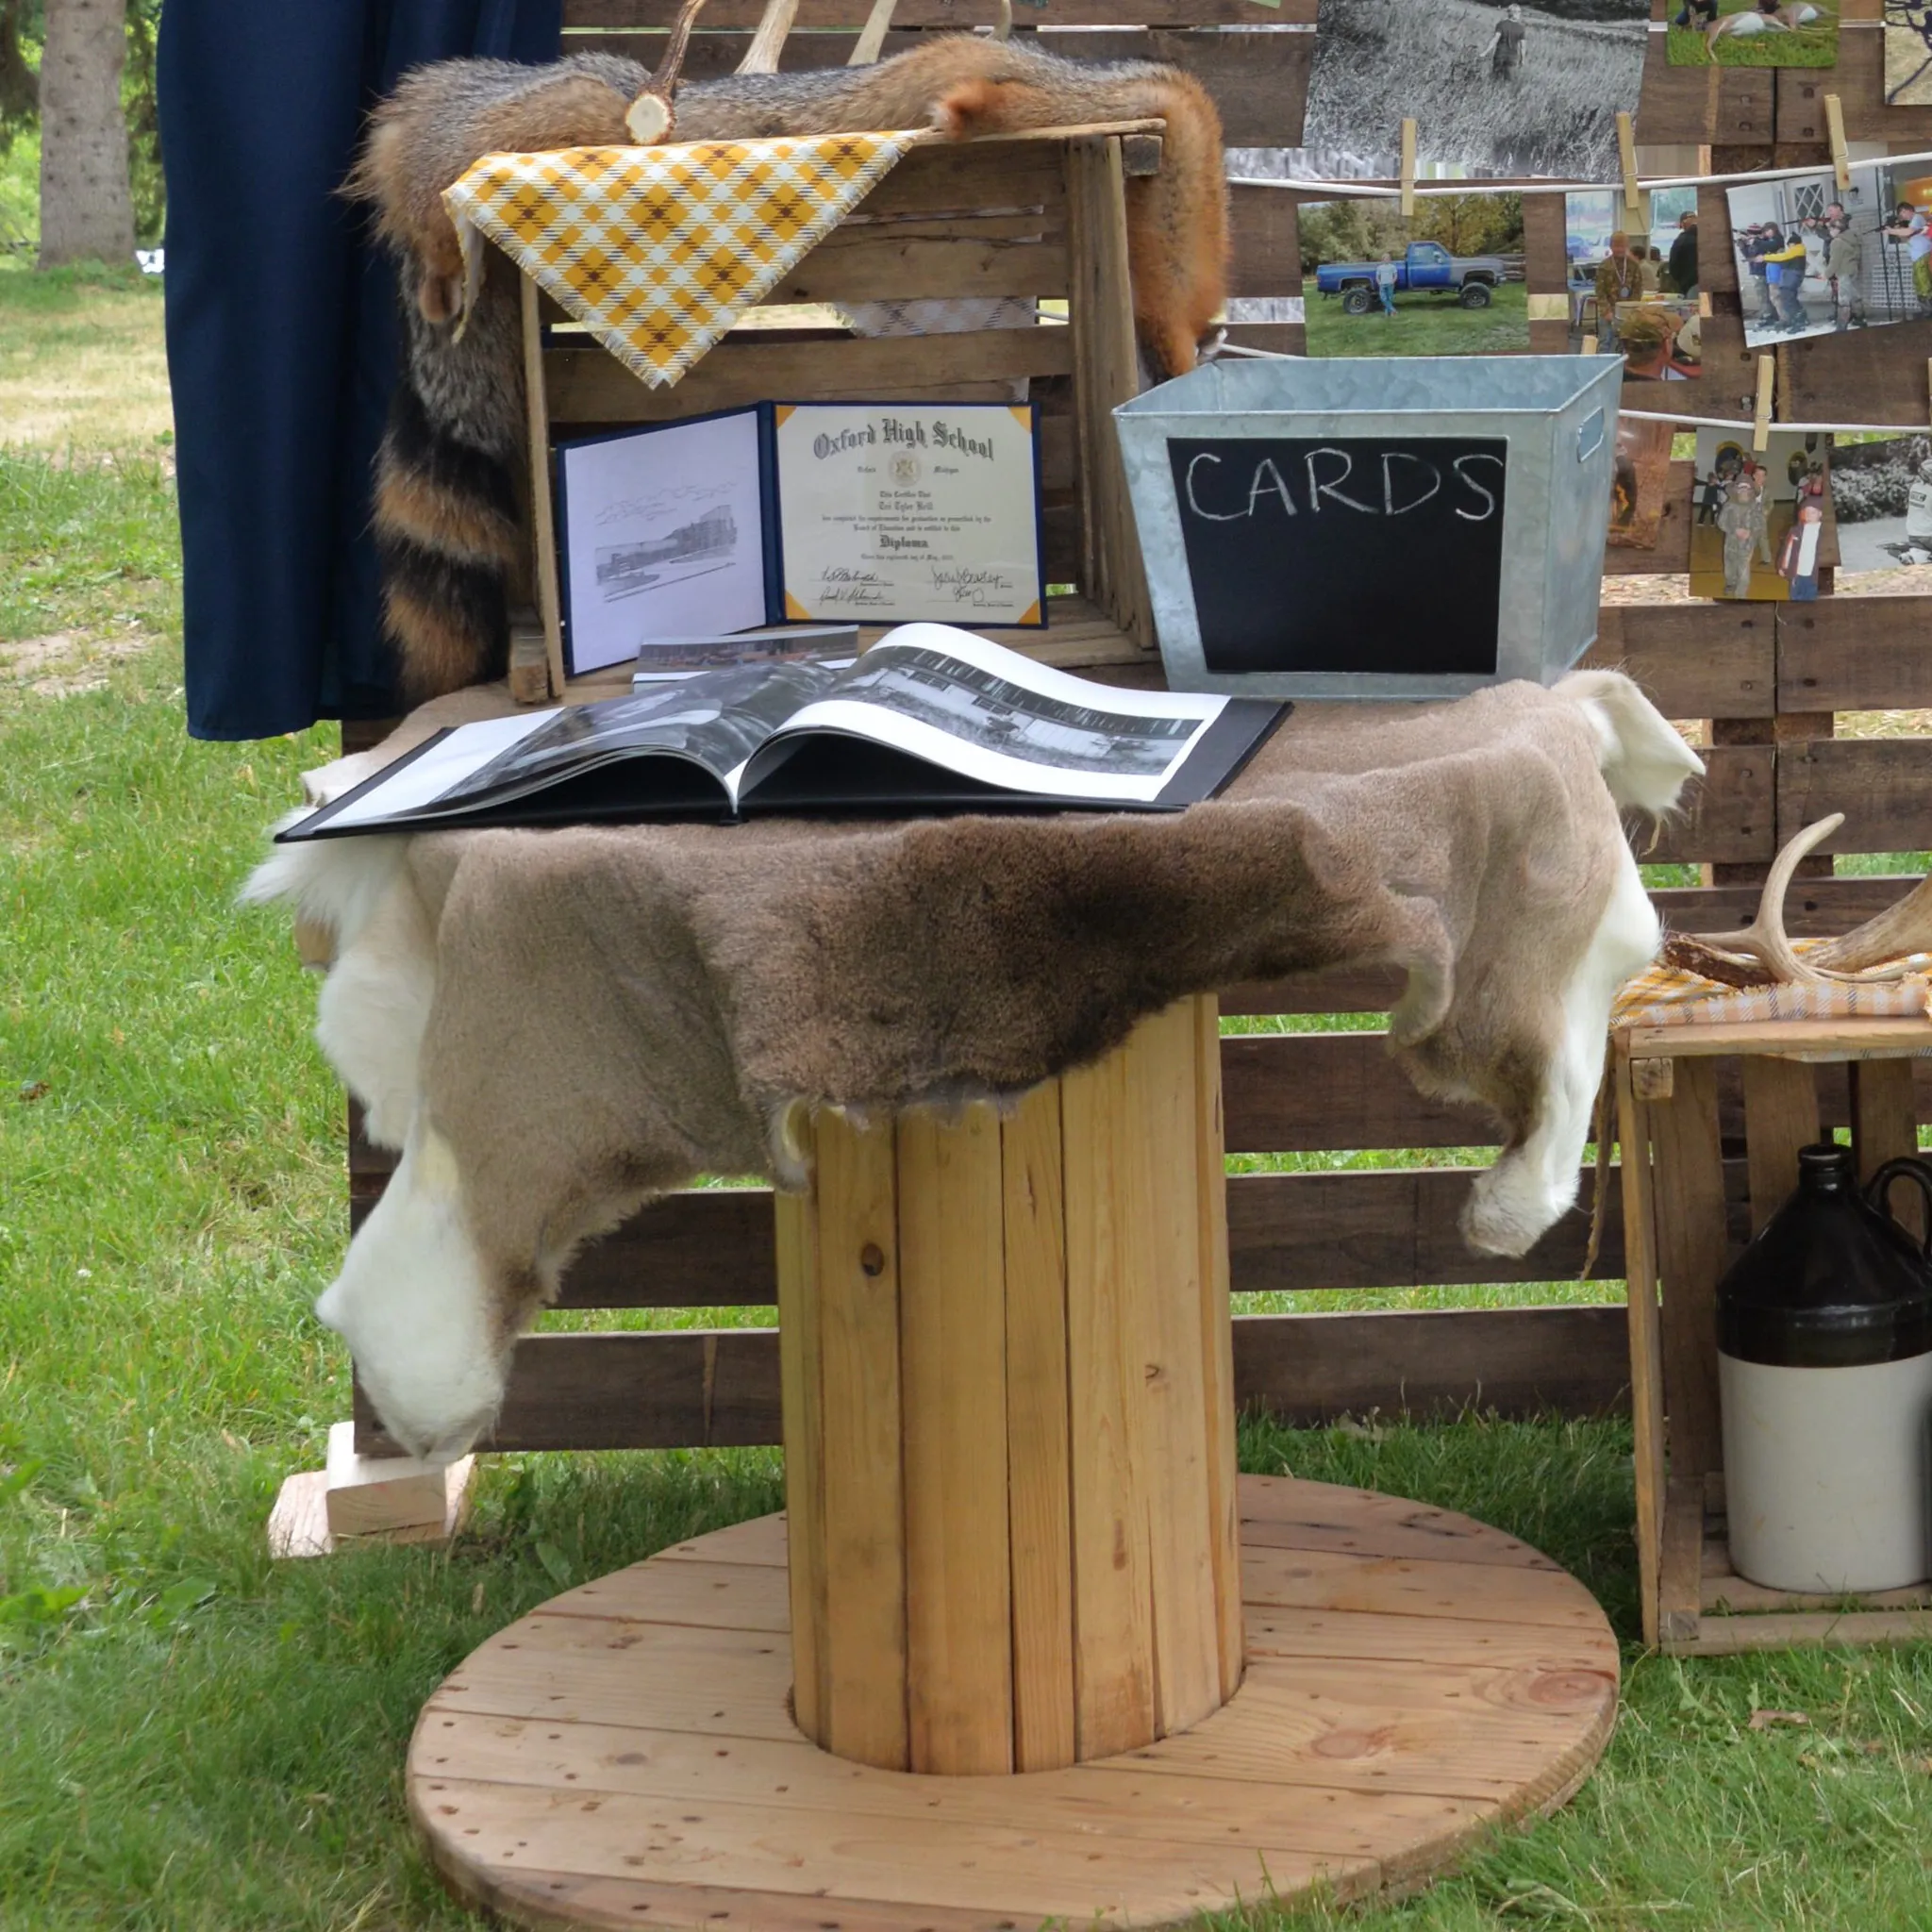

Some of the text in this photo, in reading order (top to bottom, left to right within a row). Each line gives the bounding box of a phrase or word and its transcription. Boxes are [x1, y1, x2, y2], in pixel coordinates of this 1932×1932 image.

[813, 418, 994, 461] Oxford High School
[1185, 447, 1504, 521] CARDS
[879, 534, 930, 551] Diploma
